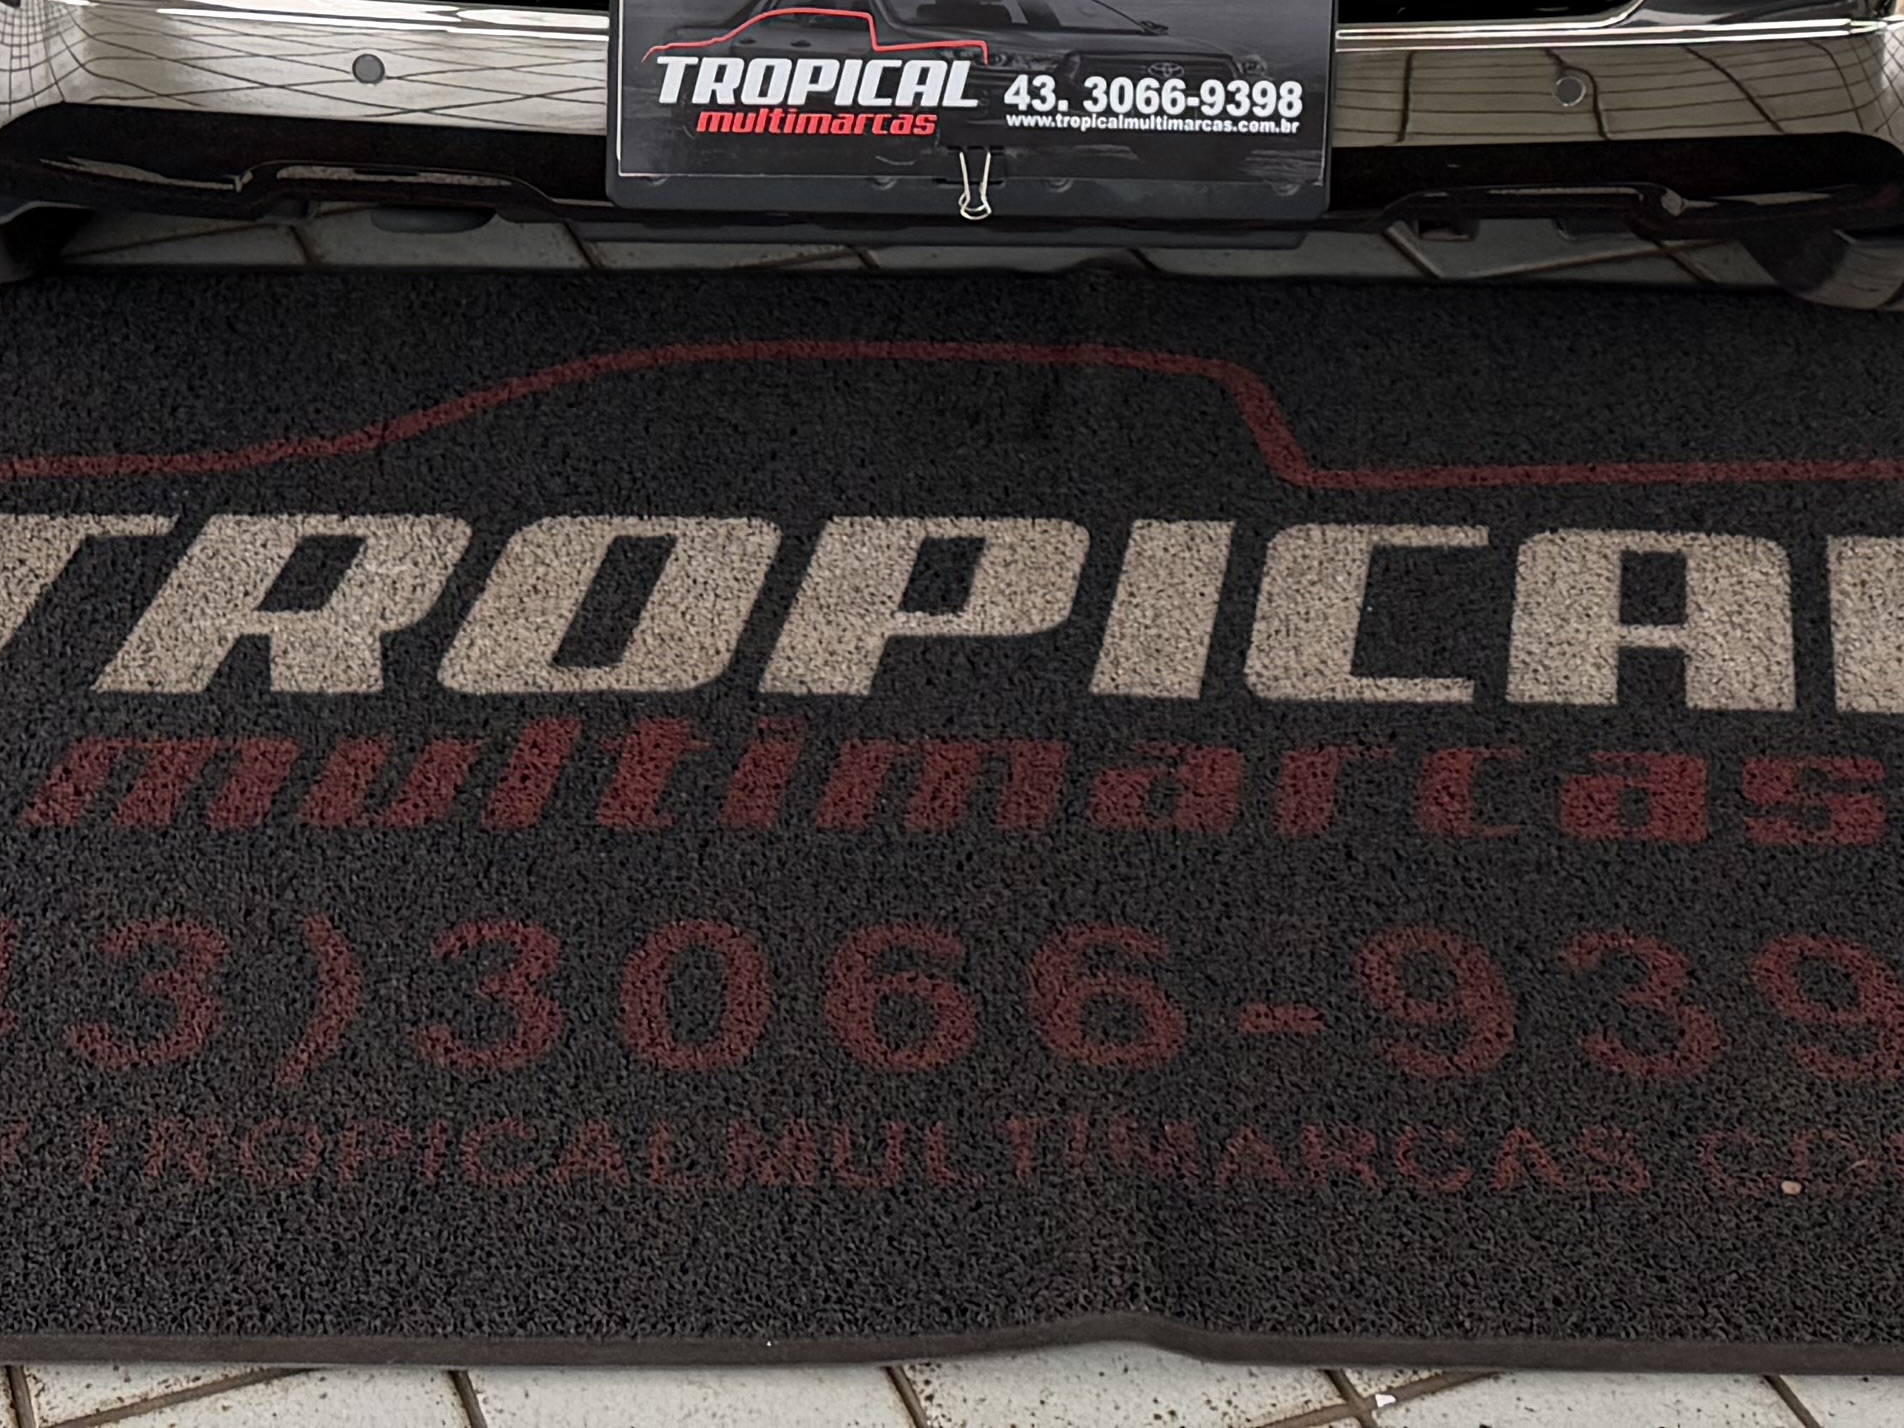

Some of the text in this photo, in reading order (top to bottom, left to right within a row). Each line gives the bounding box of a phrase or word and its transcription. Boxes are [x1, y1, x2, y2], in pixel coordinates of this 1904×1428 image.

[656, 56, 979, 108] TROPICAL
[1003, 74, 1303, 118] 43. 3066-9398
[696, 108, 938, 135] multimarcas
[1005, 112, 1299, 134] www.tropicalmultimarcas.com.br
[16, 717, 1890, 847] multimarcas
